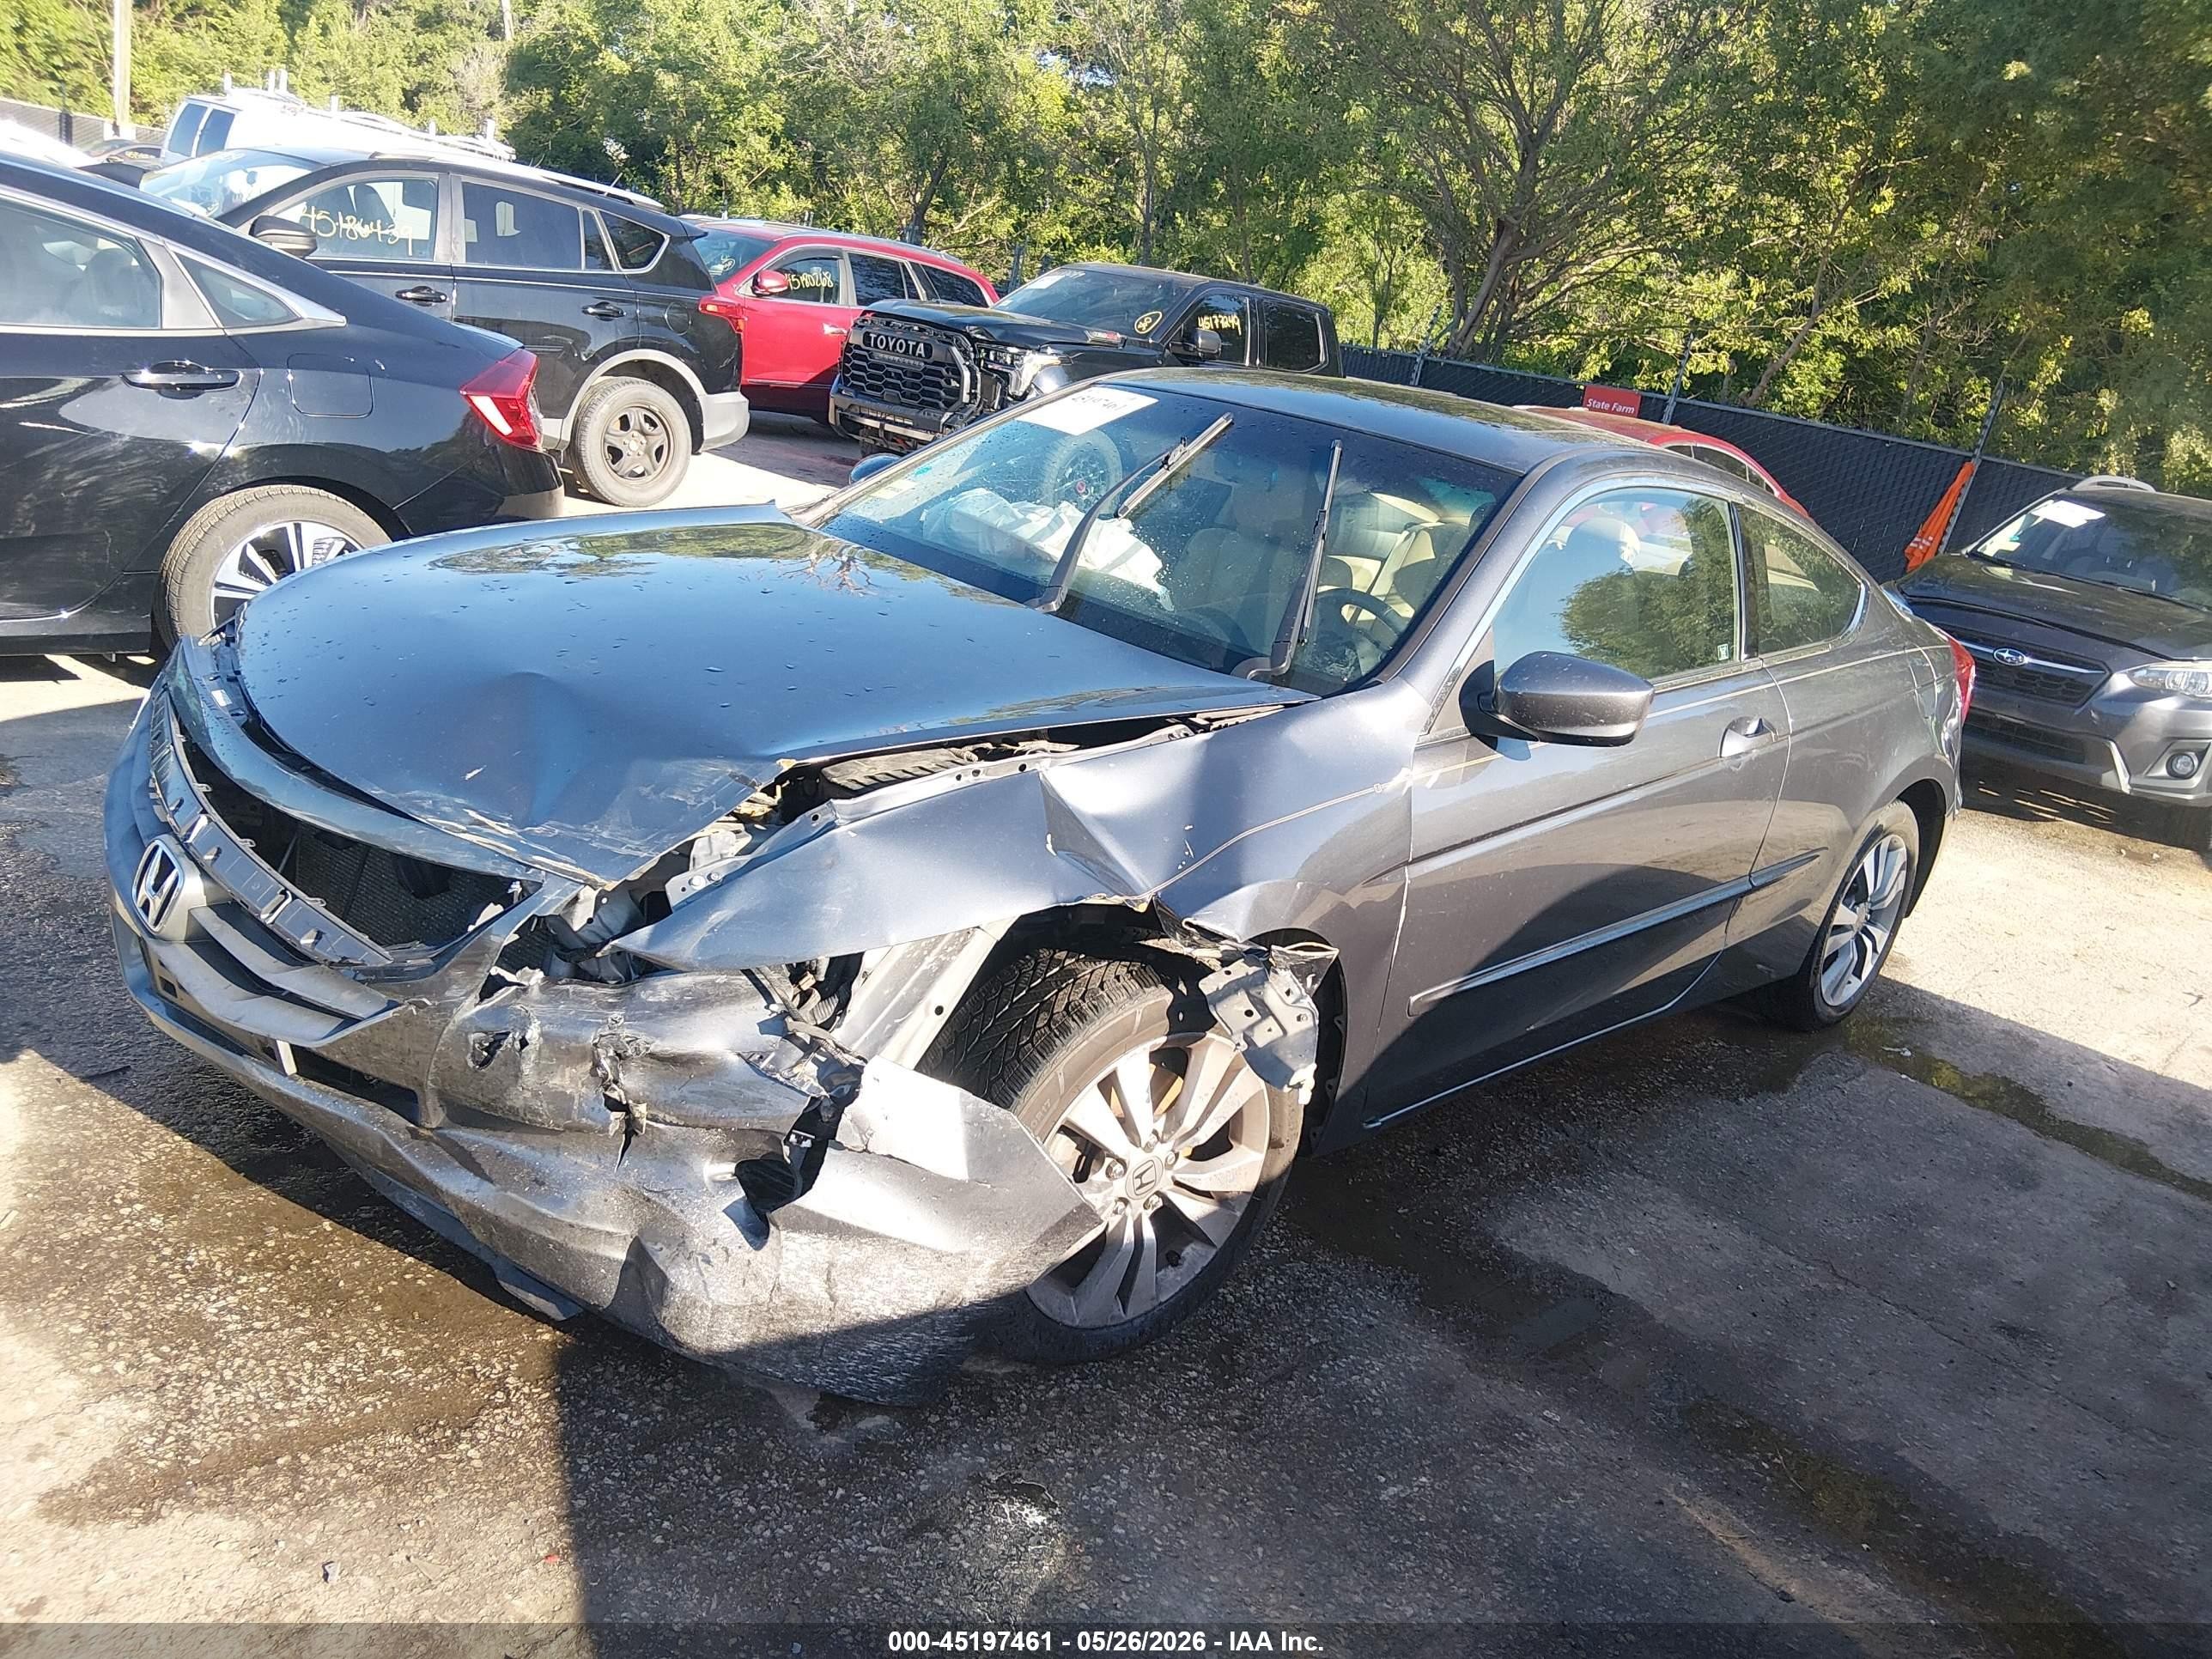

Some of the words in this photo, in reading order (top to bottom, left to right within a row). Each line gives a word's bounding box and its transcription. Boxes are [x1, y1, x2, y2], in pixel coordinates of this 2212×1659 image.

[869, 333, 926, 358] TOYOTA
[1587, 398, 1610, 410] State
[1612, 403, 1635, 414] Farm
